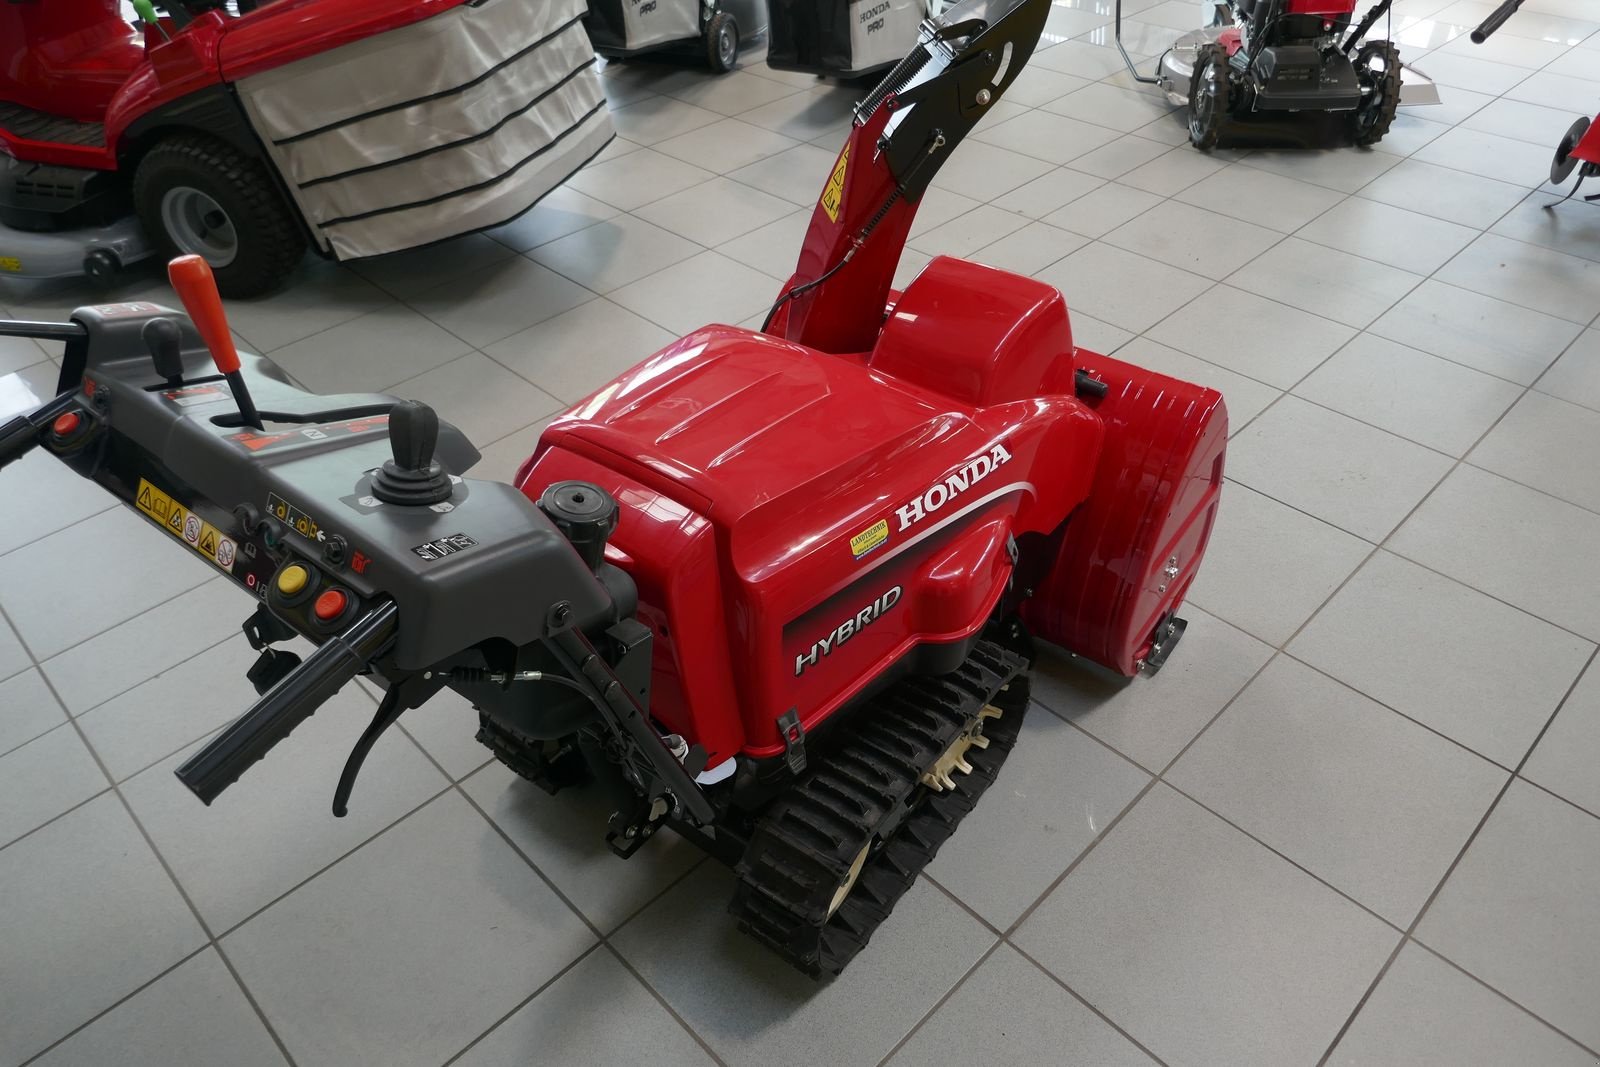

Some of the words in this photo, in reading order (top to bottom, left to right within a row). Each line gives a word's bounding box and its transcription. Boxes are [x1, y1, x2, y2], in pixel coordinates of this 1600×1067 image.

[639, 0, 657, 17] PRO
[860, 1, 891, 24] HONDA
[867, 18, 885, 36] PRO
[895, 443, 1012, 532] HONDA
[794, 585, 902, 676] HYBRID
